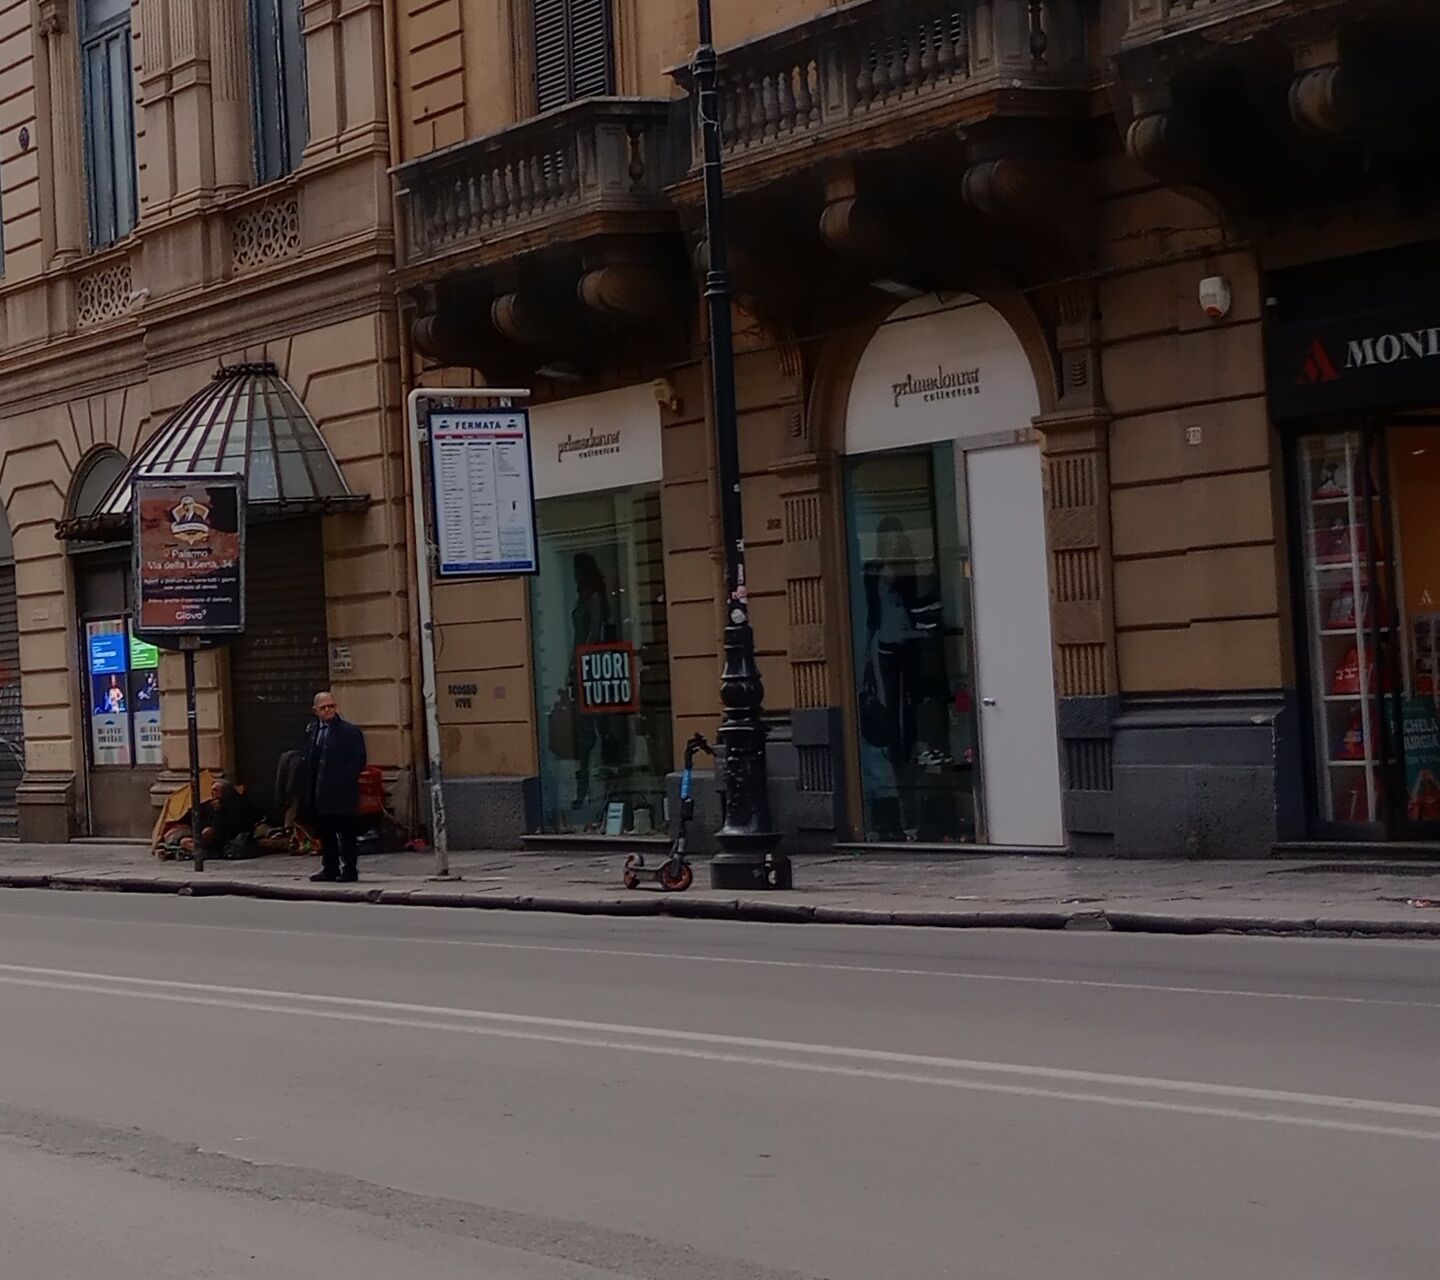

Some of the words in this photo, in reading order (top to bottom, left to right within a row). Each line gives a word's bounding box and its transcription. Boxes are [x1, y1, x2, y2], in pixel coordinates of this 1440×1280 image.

[923, 386, 980, 402] collection
[454, 421, 501, 430] FERMATA
[172, 550, 208, 558] Palermo
[175, 611, 204, 620] Glovo
[581, 652, 629, 680] FUORI
[583, 680, 631, 704] TUTTO
